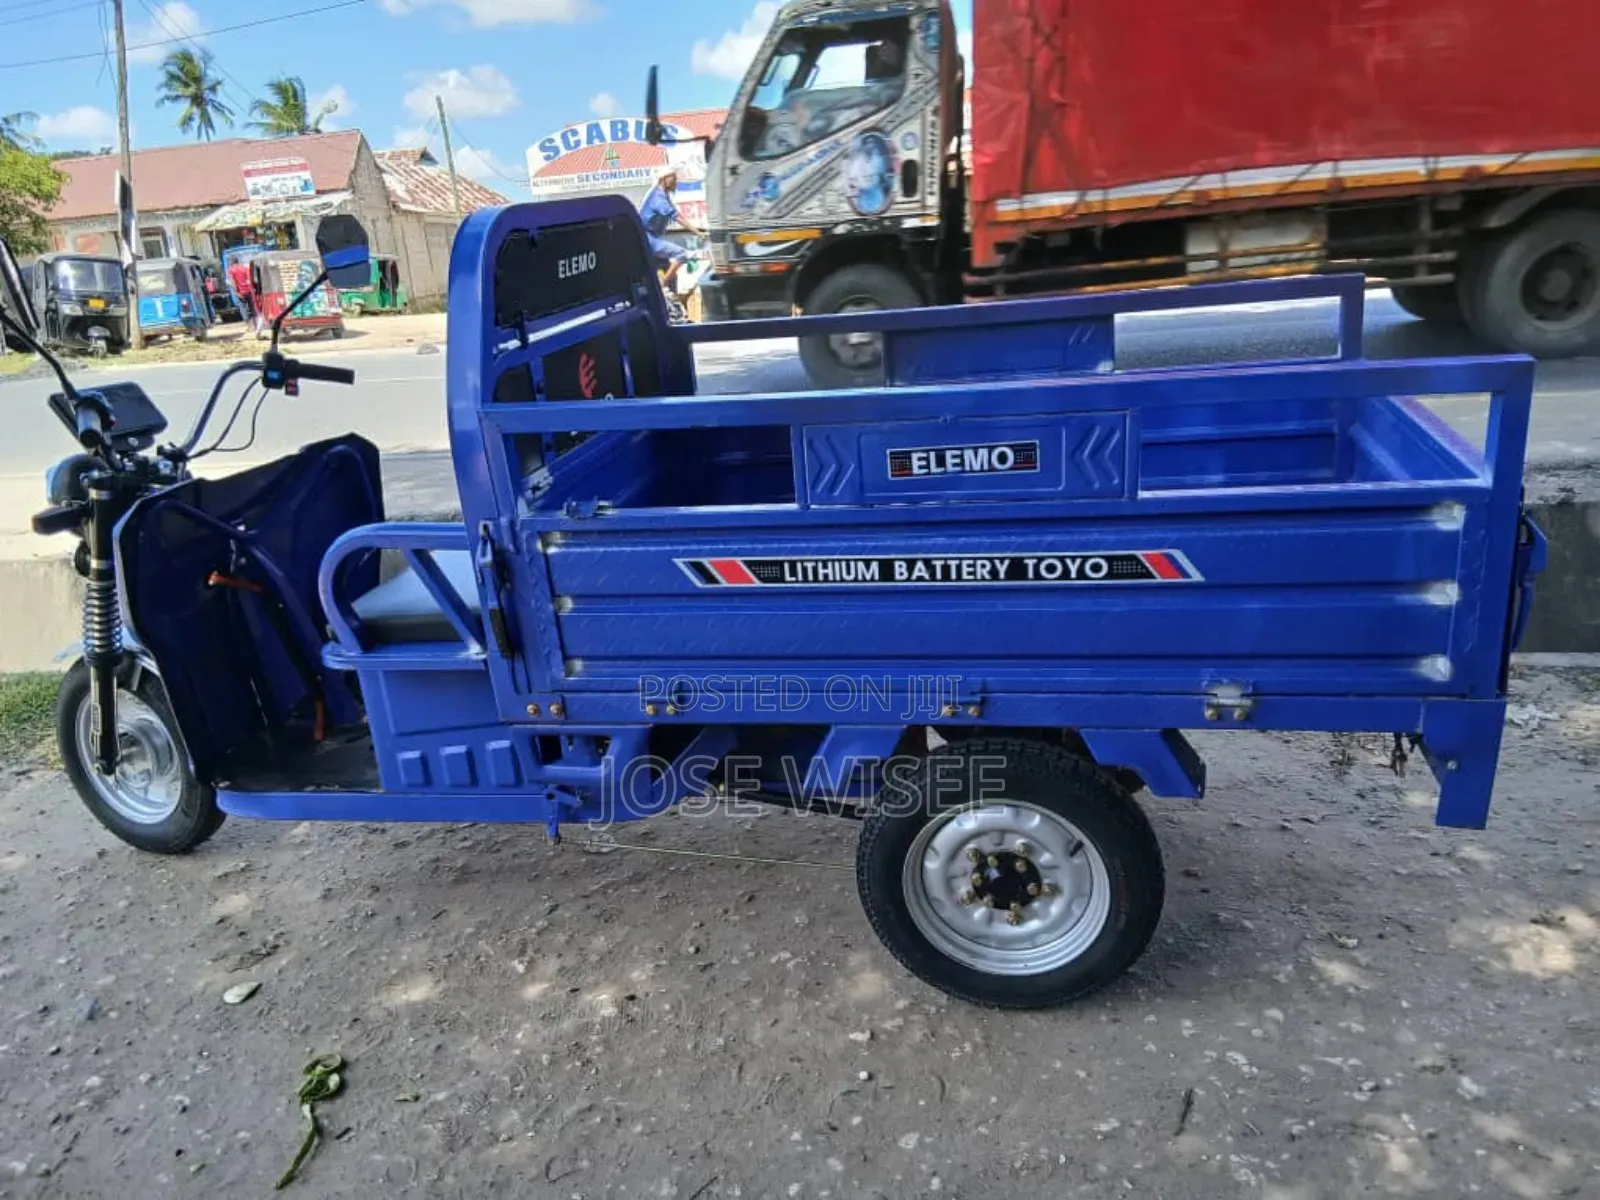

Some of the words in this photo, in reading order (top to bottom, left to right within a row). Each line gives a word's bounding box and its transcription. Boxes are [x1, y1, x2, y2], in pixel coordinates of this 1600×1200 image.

[557, 251, 597, 279] ELEMO
[911, 446, 1015, 475] ELEMO
[783, 560, 880, 582] LITHIUM
[893, 558, 1010, 580] BATTERY
[1023, 557, 1109, 579] TOYO
